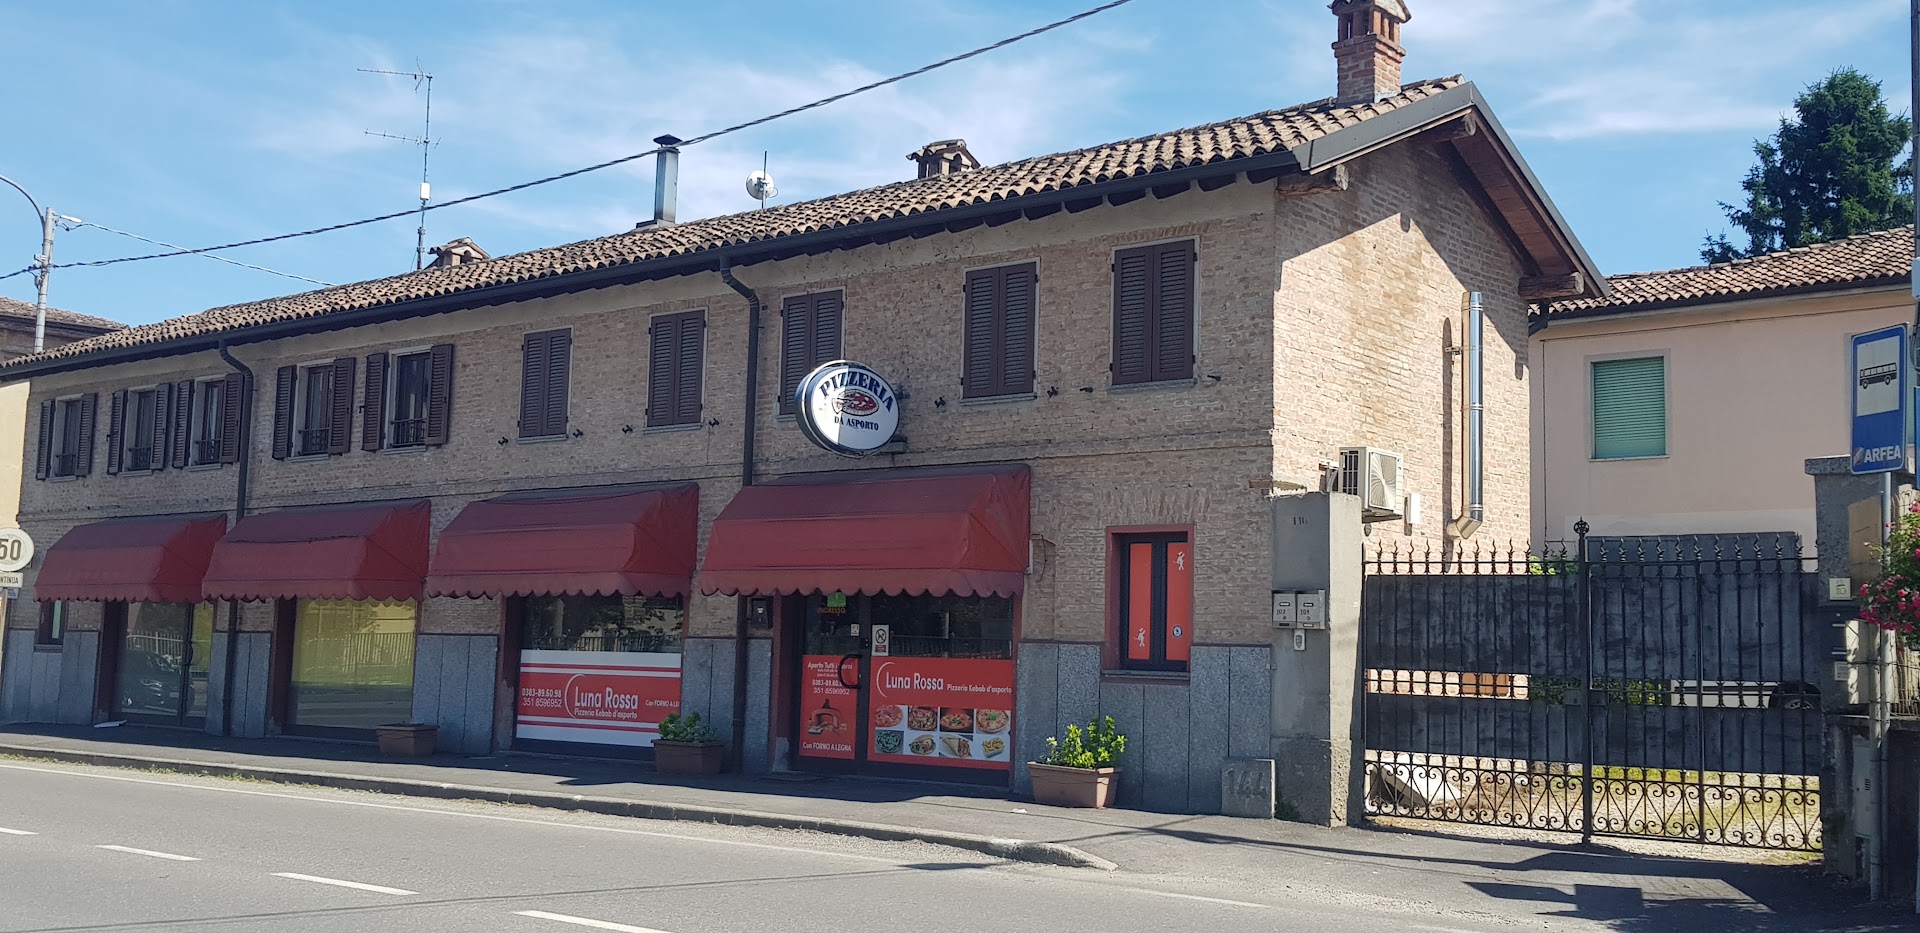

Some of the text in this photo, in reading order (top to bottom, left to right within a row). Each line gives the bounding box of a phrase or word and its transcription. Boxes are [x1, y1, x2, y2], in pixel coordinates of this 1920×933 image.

[819, 371, 894, 413] PIZZERIA
[834, 416, 879, 431] DA ASPORTO
[1864, 445, 1901, 463] ARFEA
[0, 539, 21, 561] 50
[808, 661, 824, 669] Aperto
[886, 671, 944, 690] Luna Rossa
[946, 683, 968, 691] Pizzeria
[969, 684, 986, 692] Kebab
[522, 697, 562, 708] 351 8596952
[574, 686, 639, 710] Luna Rossa
[574, 707, 638, 720] Pizzeria Kebab d'asporto
[812, 742, 830, 751] FORNO
[830, 743, 835, 751] A
[835, 744, 852, 752] LEGNA
